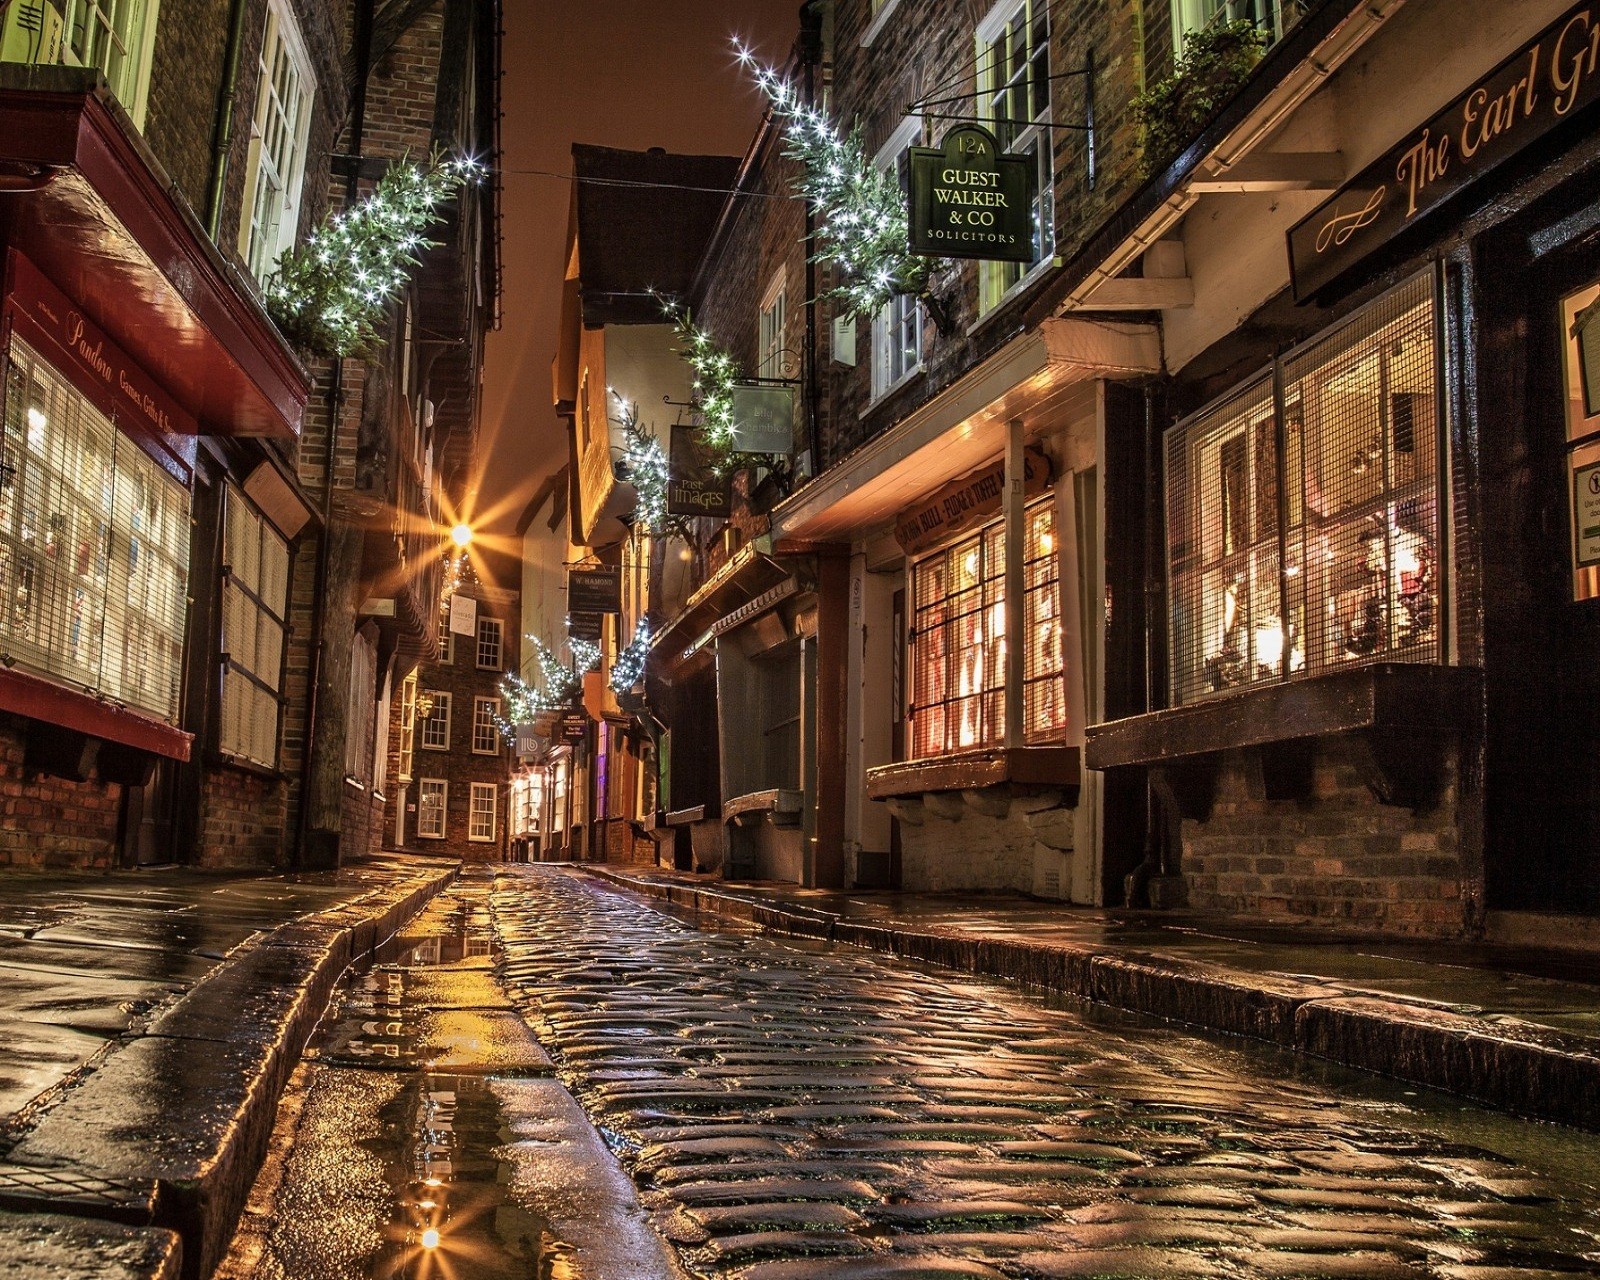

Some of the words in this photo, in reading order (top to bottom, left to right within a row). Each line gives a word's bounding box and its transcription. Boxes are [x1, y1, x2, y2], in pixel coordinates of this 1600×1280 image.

[1396, 128, 1449, 218] The
[1462, 44, 1540, 158] Earl
[958, 137, 986, 154] 12A
[942, 169, 1000, 187] GUEST
[934, 188, 1009, 208] WALKER
[949, 211, 963, 225] &
[967, 211, 994, 226] CO
[927, 229, 1015, 244] SOLICITORS
[66, 310, 113, 383] Pandora
[682, 479, 704, 490] Past
[920, 505, 944, 532] BULL
